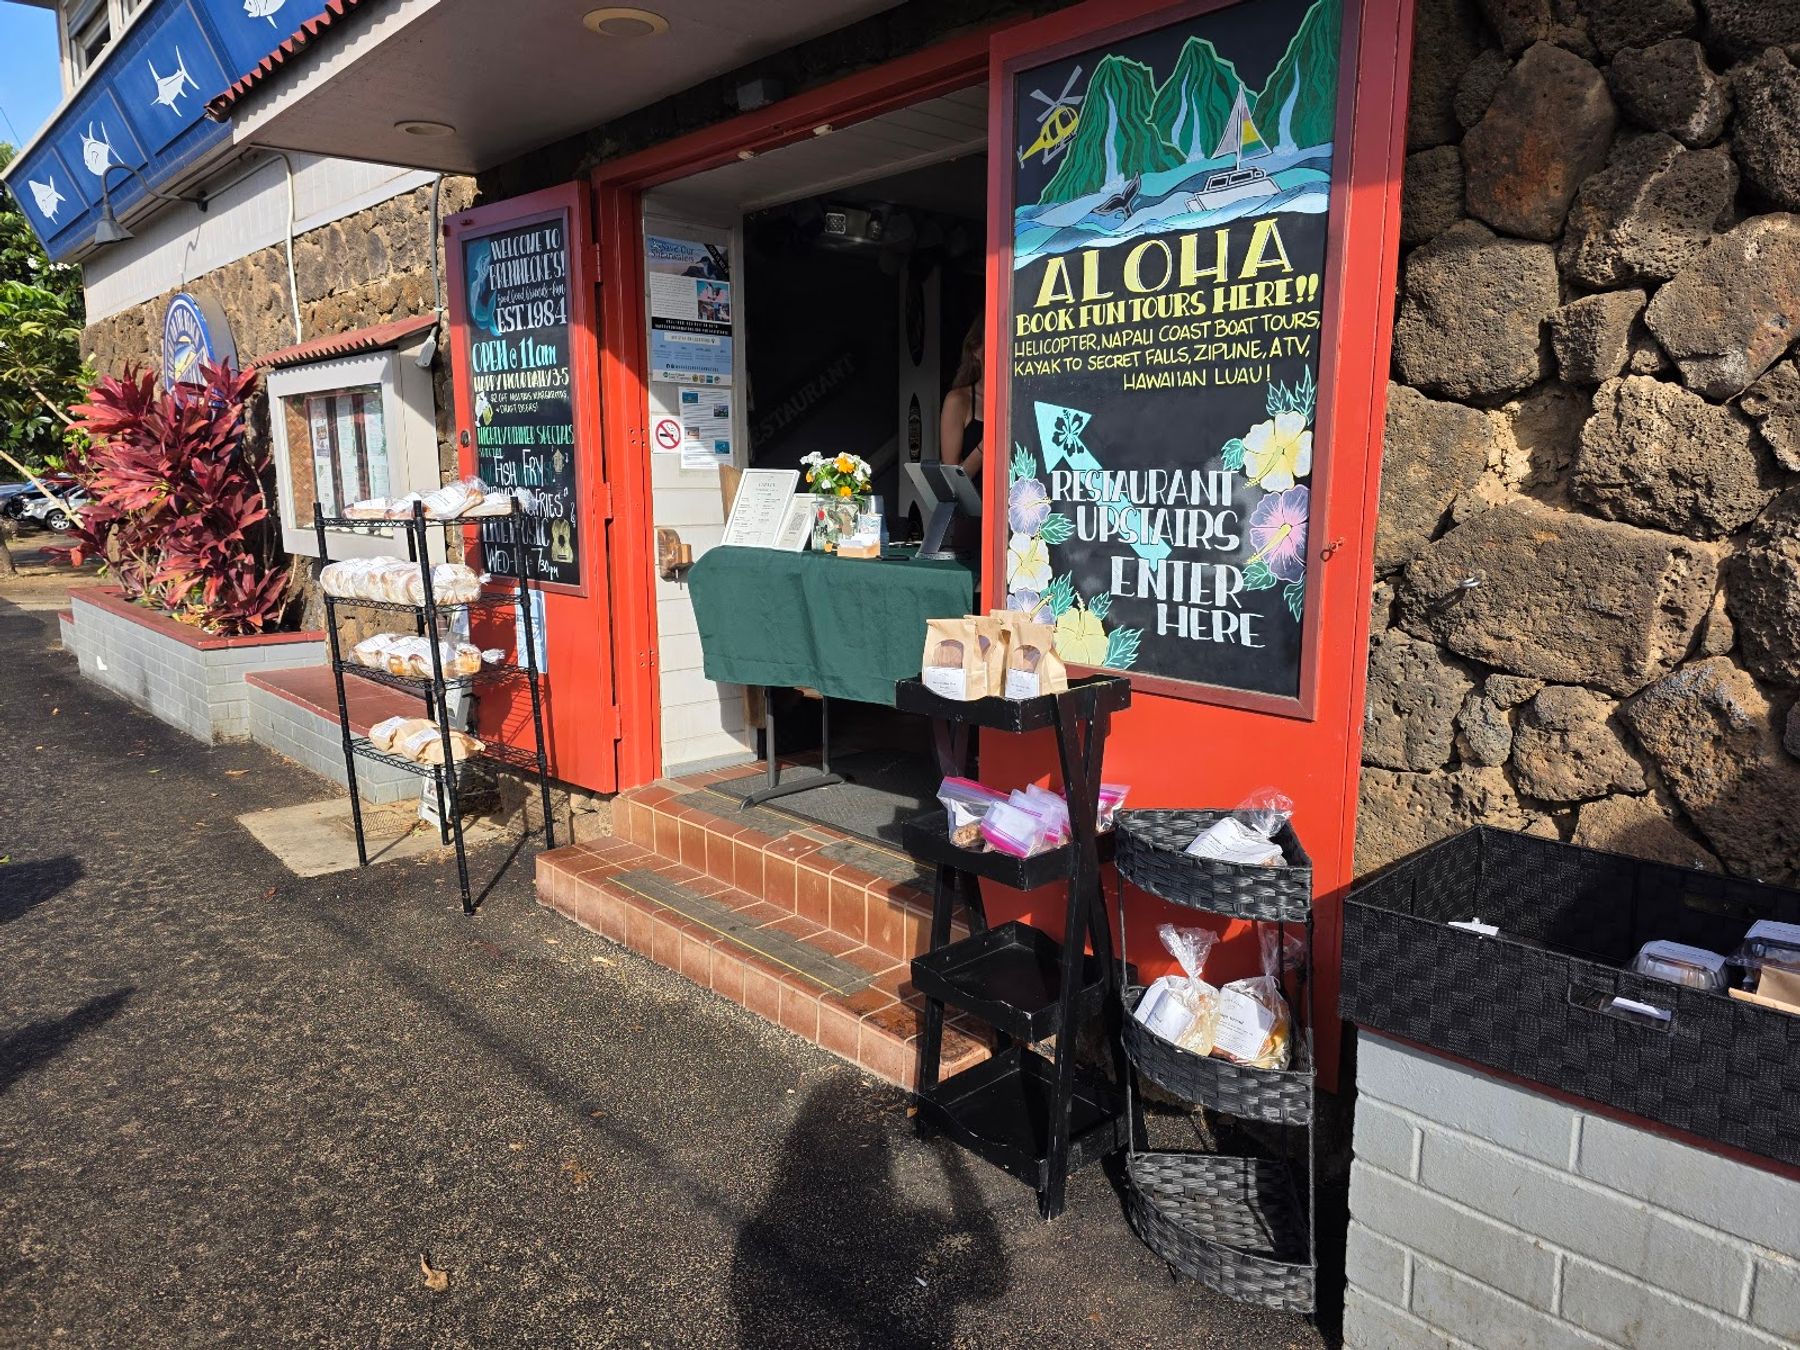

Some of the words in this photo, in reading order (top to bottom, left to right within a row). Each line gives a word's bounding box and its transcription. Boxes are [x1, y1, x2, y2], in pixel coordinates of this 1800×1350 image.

[543, 229, 560, 250] TO
[681, 246, 694, 256] Our
[1034, 218, 1294, 308] ALOHA
[1015, 306, 1075, 337] BOOK
[1080, 302, 1130, 328] FUN
[1130, 291, 1205, 324] TOURS
[1212, 273, 1320, 315] HERE!!
[1102, 327, 1154, 351] NAPALI
[1159, 321, 1212, 343] COAST
[1216, 316, 1259, 338] BOAT
[1261, 310, 1322, 332] TOURS,
[473, 338, 509, 373] OPEN
[1014, 358, 1062, 378] KAYAK
[1062, 356, 1083, 372] TO
[1087, 350, 1141, 372] SECRET
[1145, 347, 1193, 367] FALLS,
[1194, 341, 1267, 363] ZIPLINE,
[1123, 368, 1207, 391] HAWAIIAN
[1214, 364, 1272, 386] LUAU!
[522, 448, 545, 488] FRY
[1051, 468, 1240, 507] RESTAURANT
[1076, 505, 1240, 552] UPSTAIRS
[1110, 555, 1245, 609] ENTER
[1156, 603, 1266, 649] HERE
